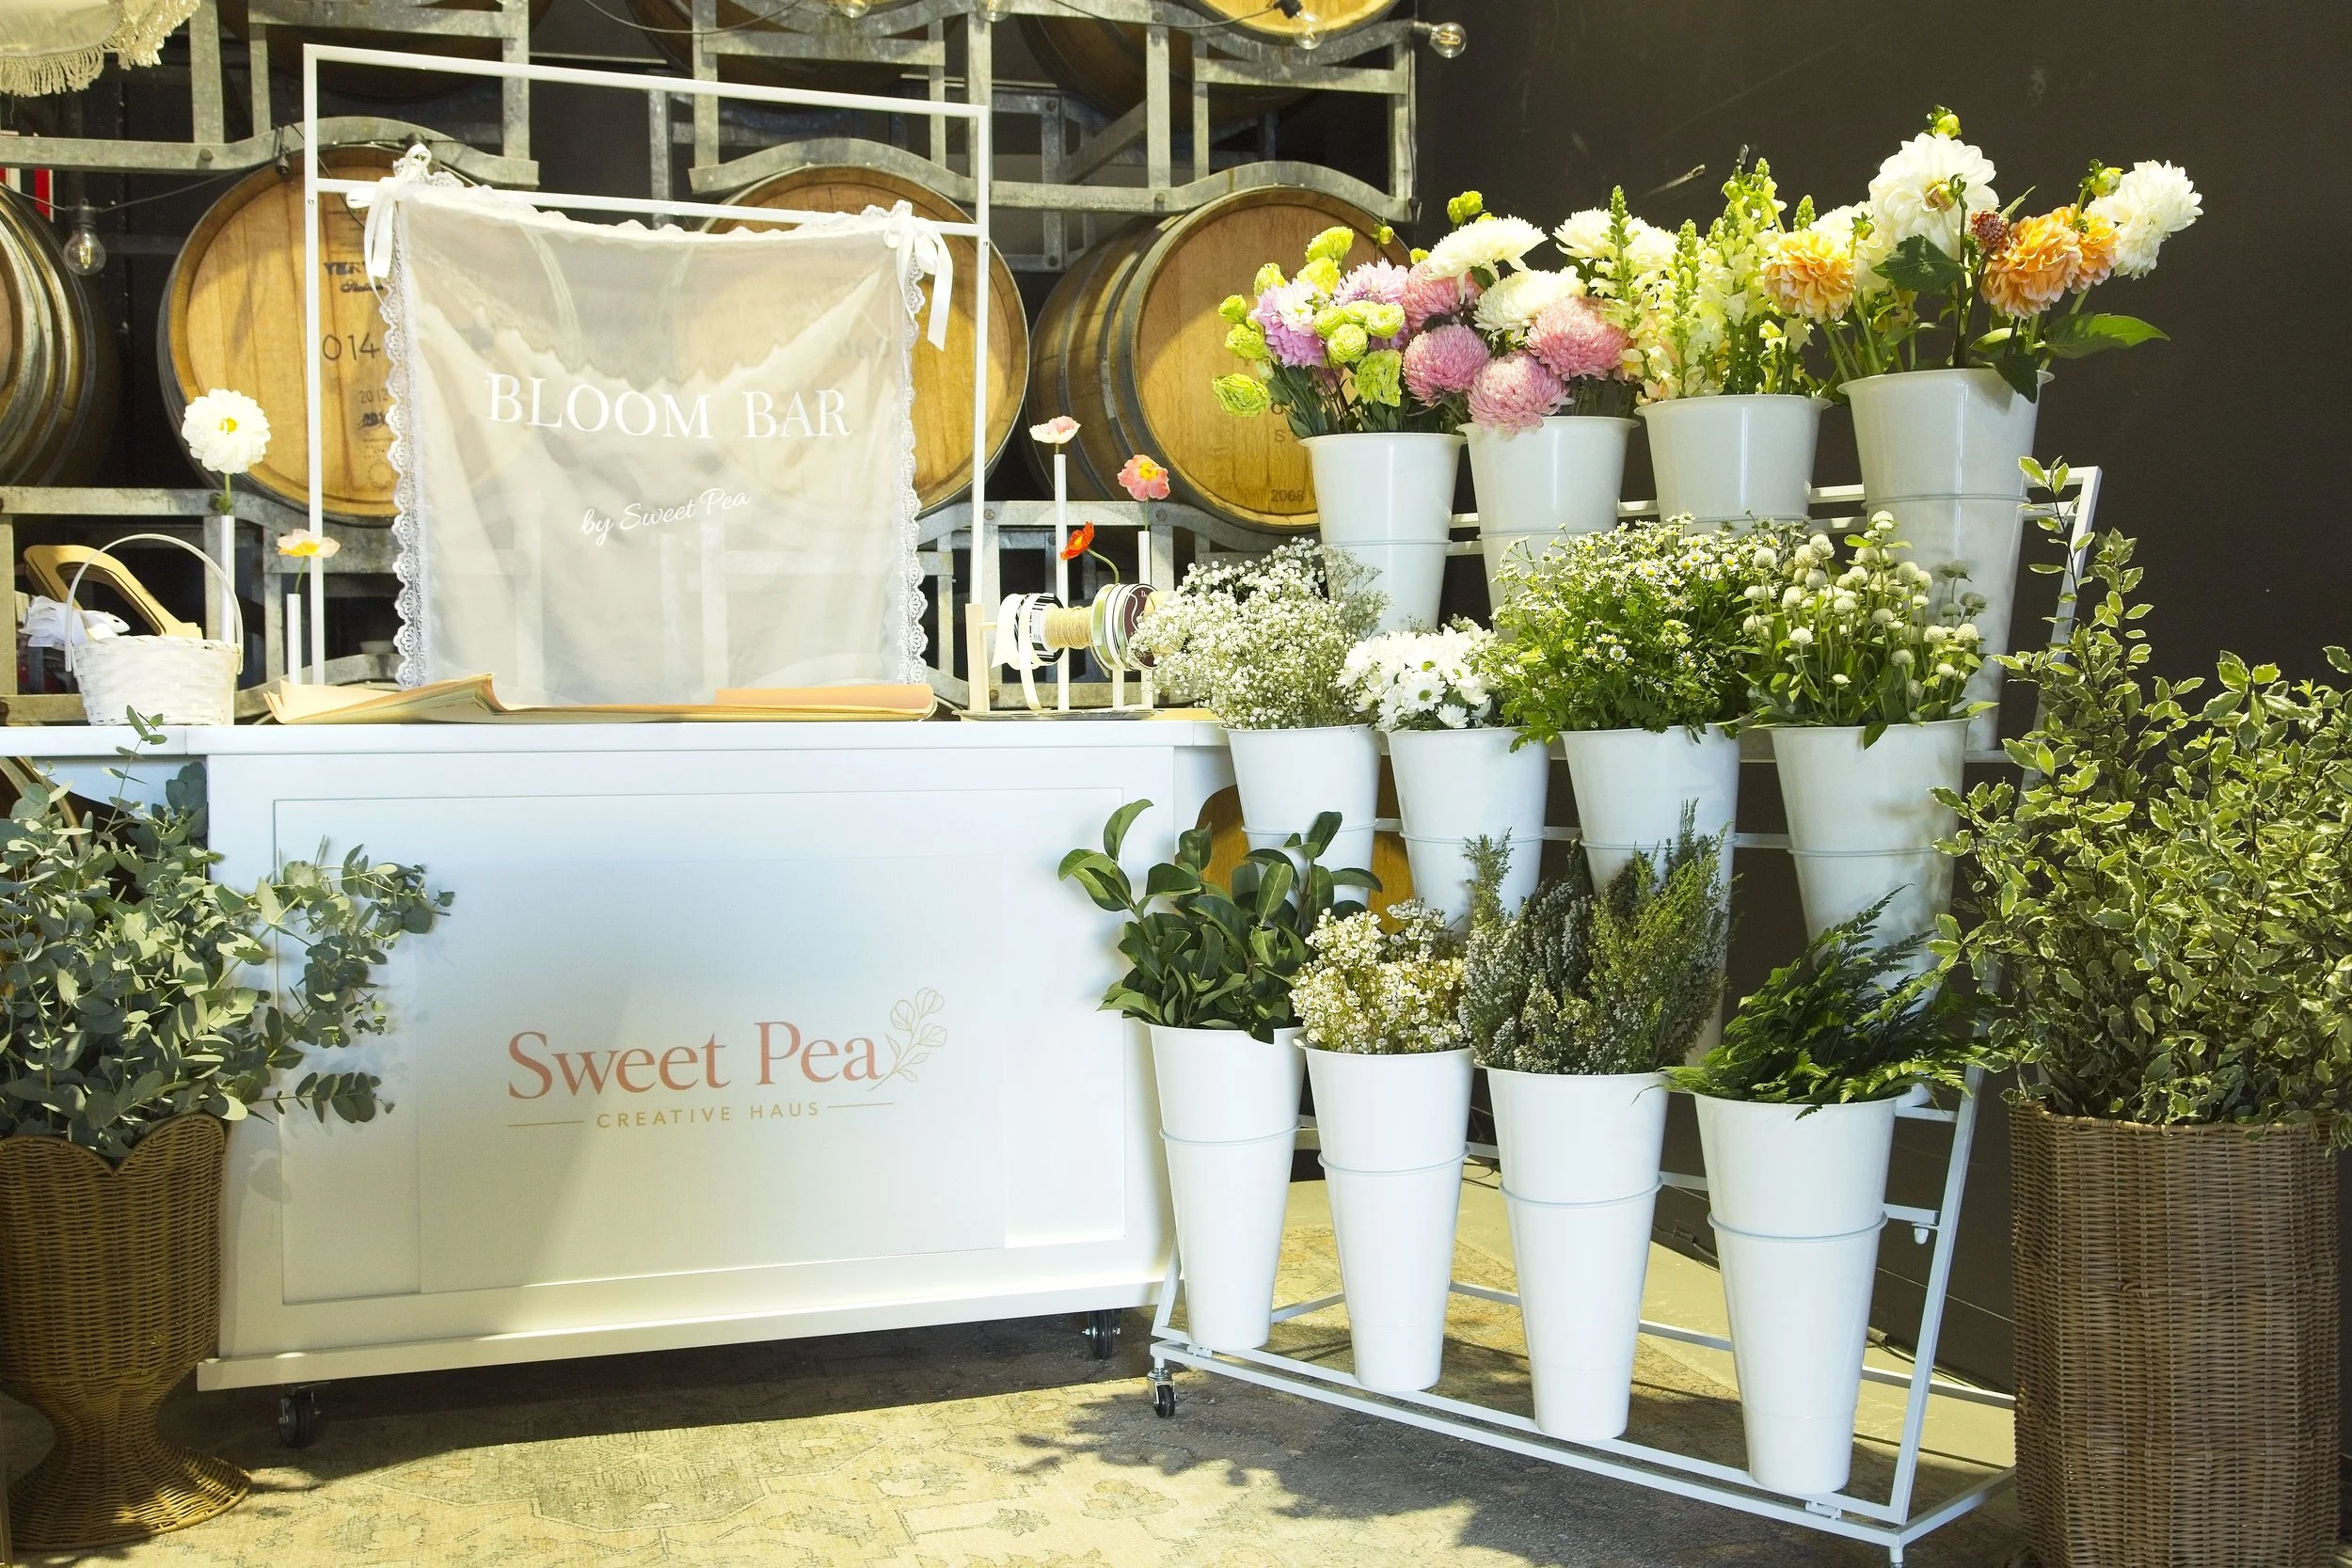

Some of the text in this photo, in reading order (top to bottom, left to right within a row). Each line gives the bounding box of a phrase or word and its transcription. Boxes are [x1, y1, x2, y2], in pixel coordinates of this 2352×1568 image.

[485, 372, 852, 439] BLOOM BAR
[580, 487, 753, 546] by Sweet Pea
[507, 1021, 884, 1100] Sweet Pea
[596, 1101, 819, 1130] CREATIVE HAUS
